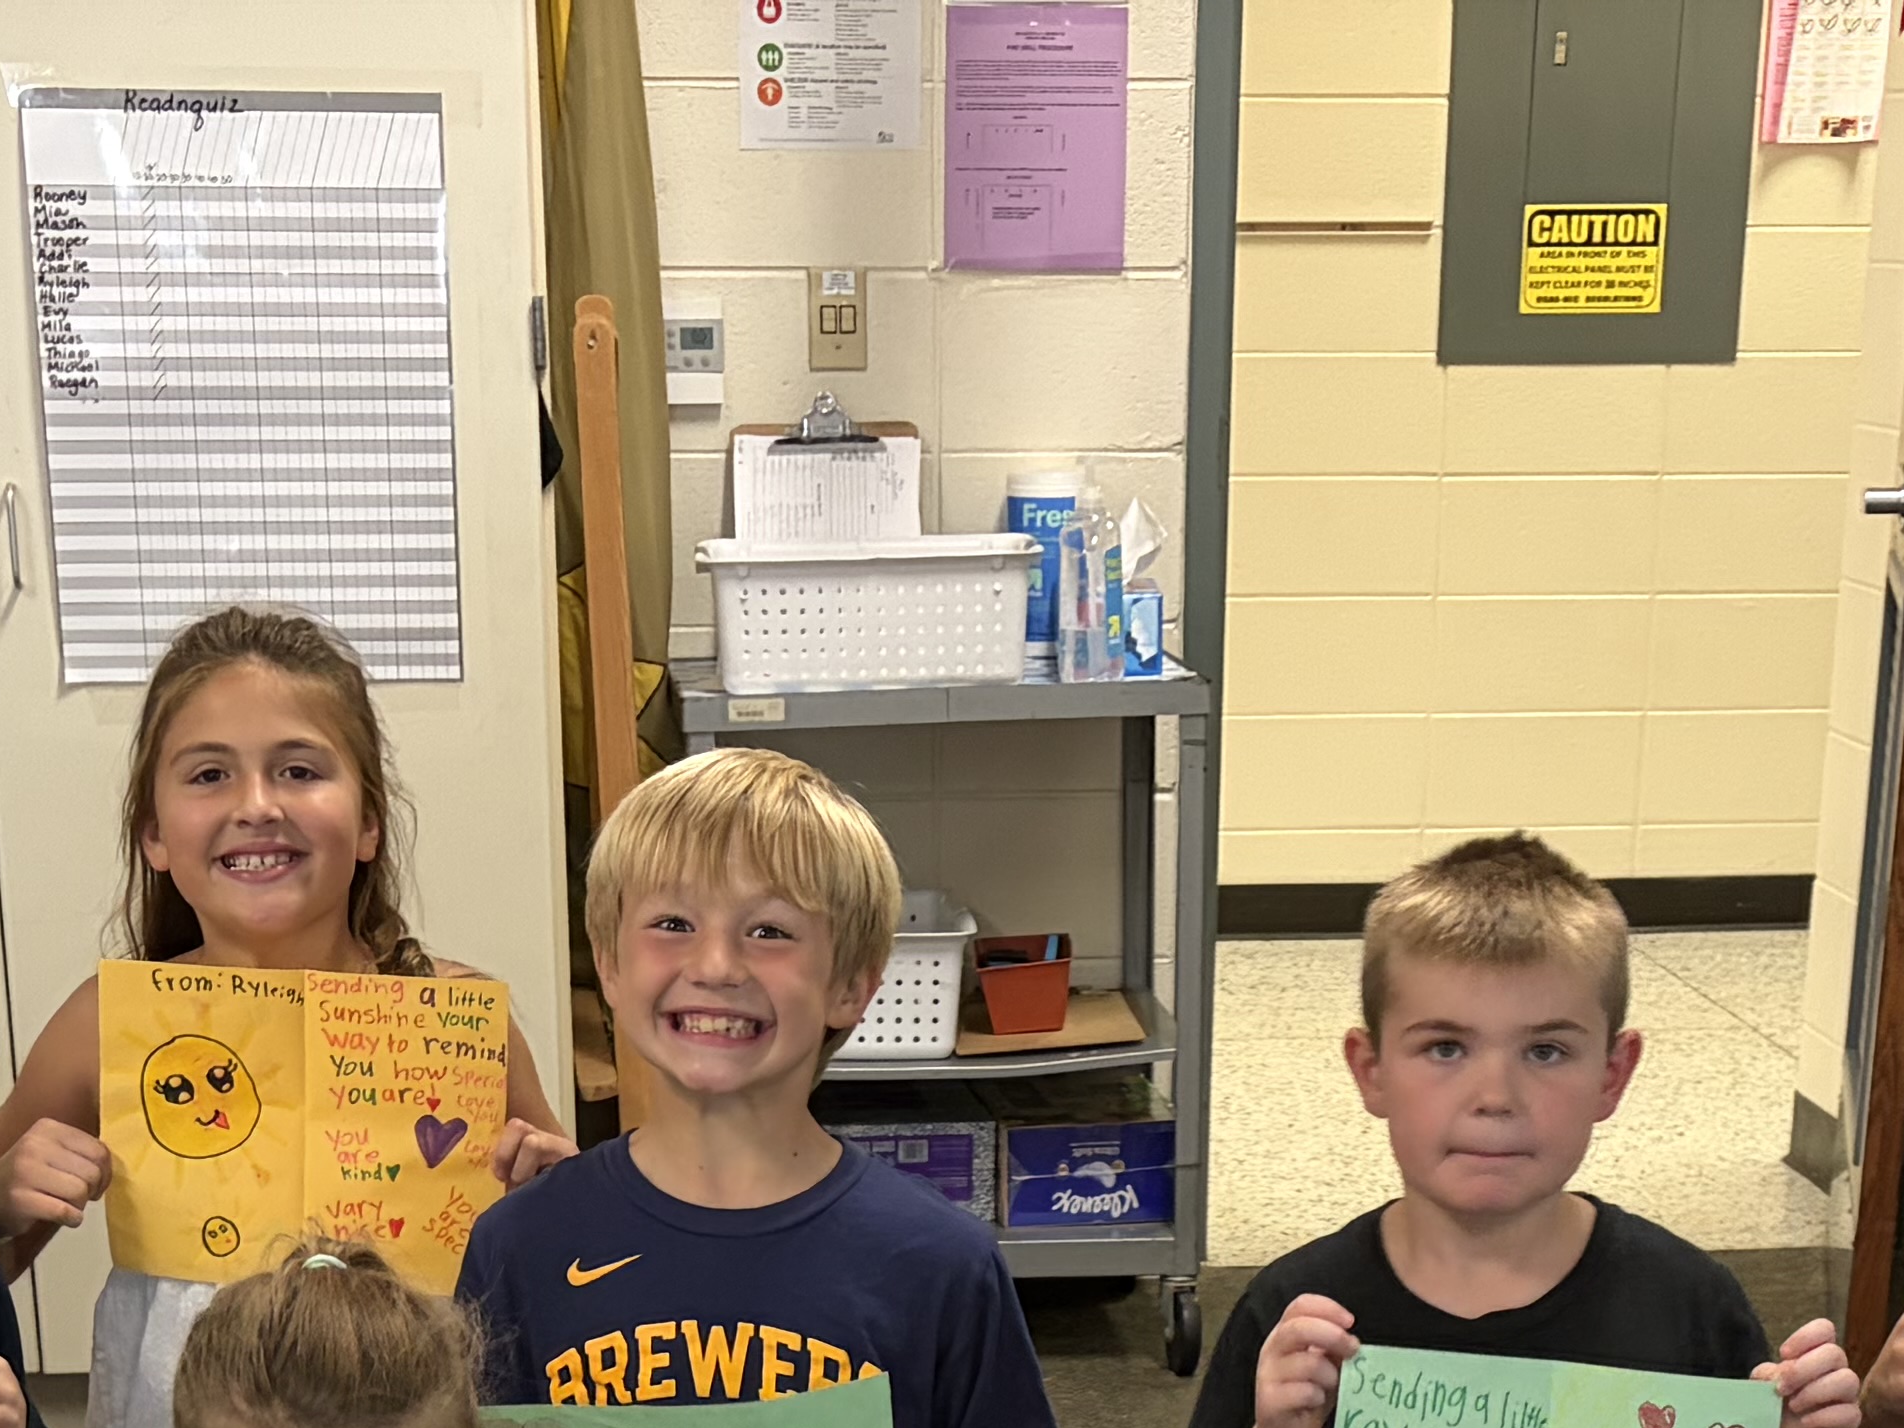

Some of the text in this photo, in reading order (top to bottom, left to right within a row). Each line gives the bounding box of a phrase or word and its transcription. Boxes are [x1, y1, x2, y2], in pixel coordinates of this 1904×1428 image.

[1532, 214, 1656, 243] CAUTION
[1539, 250, 1564, 259] AREA
[1577, 250, 1608, 259] FRONT
[1610, 250, 1622, 258] OF
[1627, 250, 1647, 258] THIS
[1553, 280, 1581, 289] CLEAR
[232, 974, 304, 1006] Ryleigh
[307, 973, 495, 1011] Sending a little
[388, 1033, 506, 1067] to remind
[394, 1060, 448, 1081] how
[341, 1163, 382, 1182] kind
[1050, 1184, 1140, 1219] Kleenex
[545, 1320, 885, 1408] BREWER
[1352, 1357, 1467, 1427] Sending
